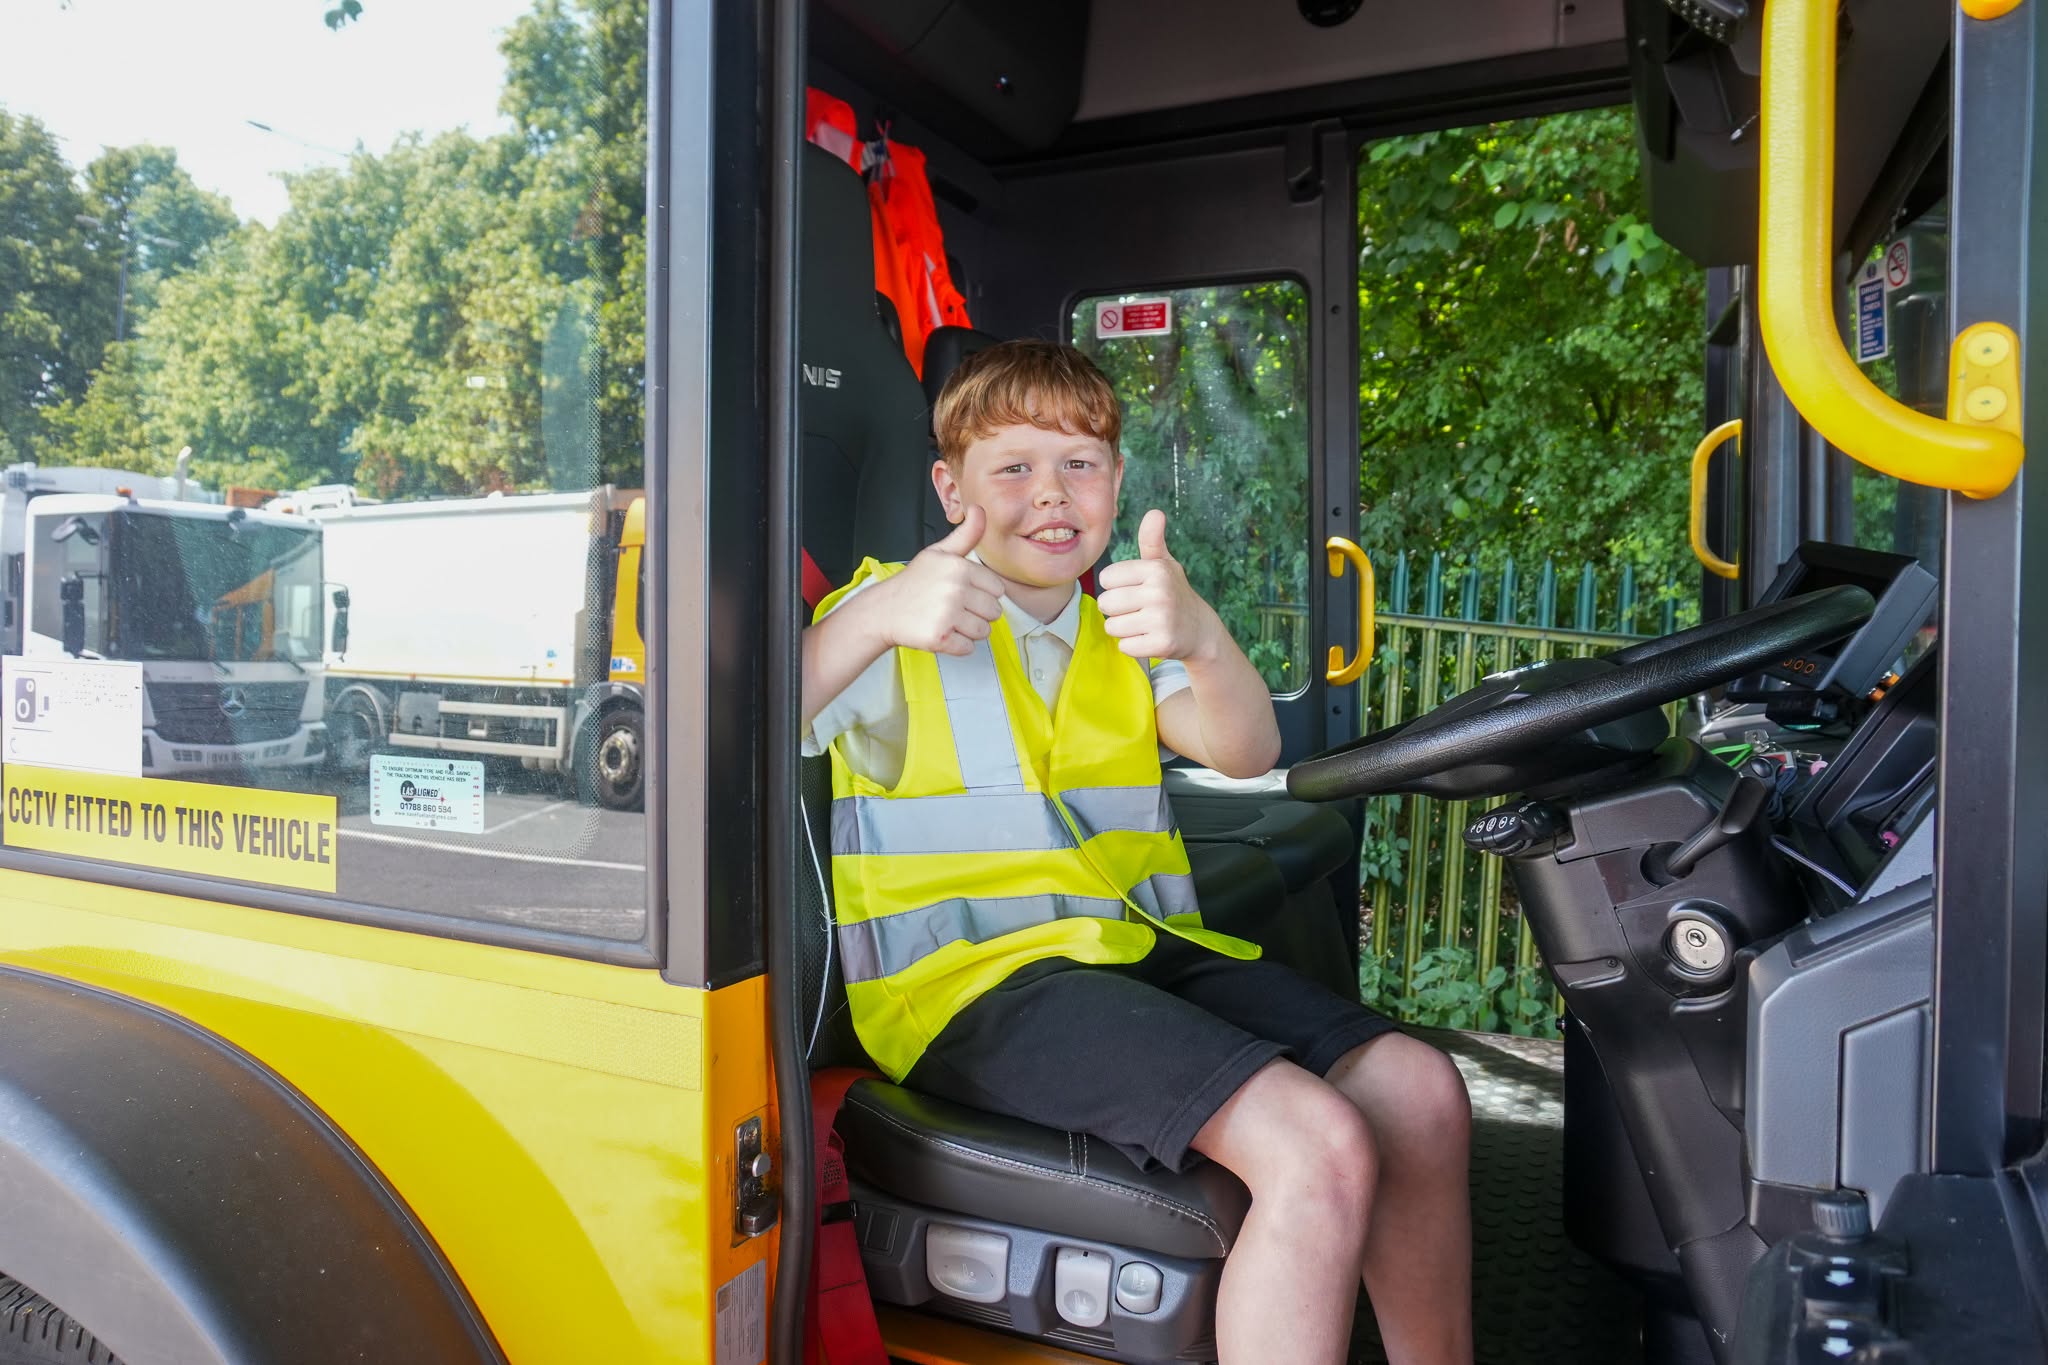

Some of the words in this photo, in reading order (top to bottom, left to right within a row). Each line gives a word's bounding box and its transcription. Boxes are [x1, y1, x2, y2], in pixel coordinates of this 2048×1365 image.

[9, 786, 58, 827] CCTV
[65, 793, 132, 838] FITTED
[140, 802, 167, 843] TO
[175, 806, 224, 851] THIS
[232, 813, 331, 865] VEHICLE
[400, 802, 421, 811] 01788
[423, 804, 437, 813] 860
[438, 805, 452, 814] 594
